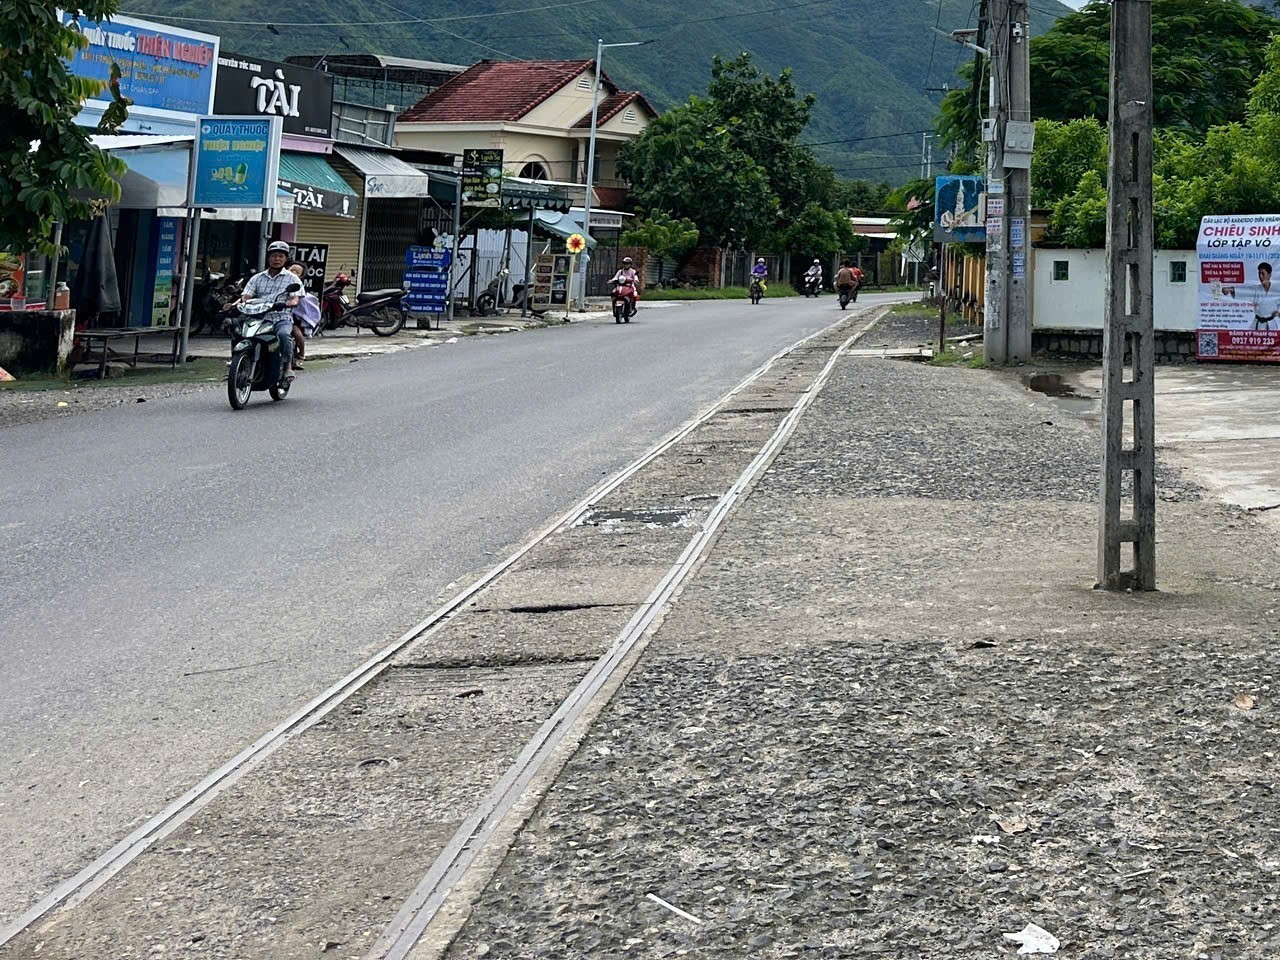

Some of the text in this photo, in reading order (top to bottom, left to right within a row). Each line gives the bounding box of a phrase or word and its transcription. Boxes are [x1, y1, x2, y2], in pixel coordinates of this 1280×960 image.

[239, 60, 249, 71] TÓC
[250, 68, 302, 118] TÀI
[293, 186, 324, 208] TÀI
[1203, 224, 1245, 237] CHIÊU
[1207, 237, 1271, 250] LỚP TẬP VÕ
[298, 246, 326, 263] TÀI
[1231, 337, 1248, 345] 0937
[1249, 337, 1262, 345] 919
